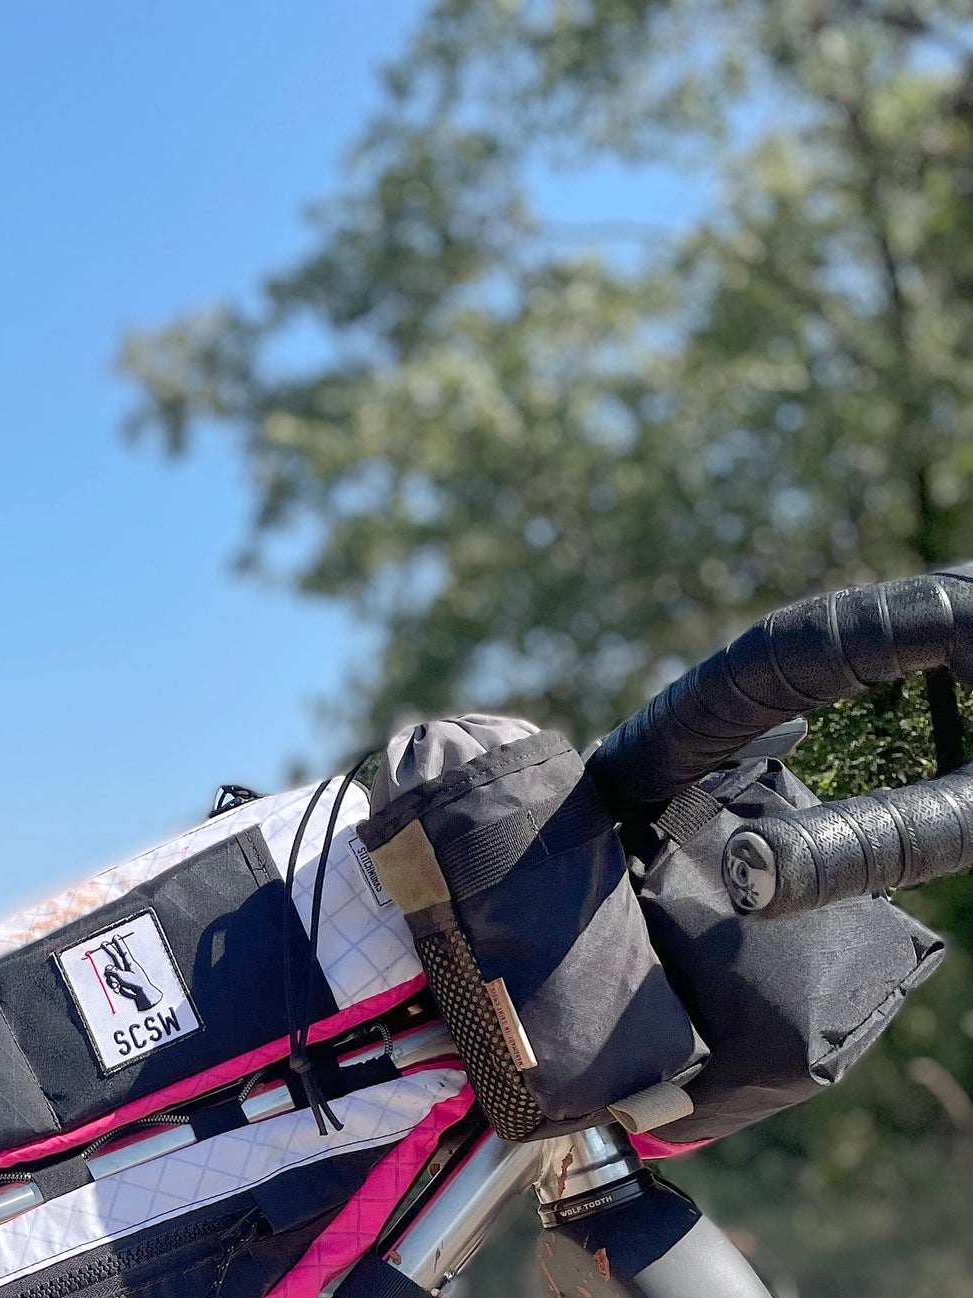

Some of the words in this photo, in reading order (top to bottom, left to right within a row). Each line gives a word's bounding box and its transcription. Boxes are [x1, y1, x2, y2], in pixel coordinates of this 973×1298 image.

[114, 1007, 181, 1056] SCSW
[560, 1206, 582, 1217] WOLF
[583, 1195, 613, 1210] TOOTH
